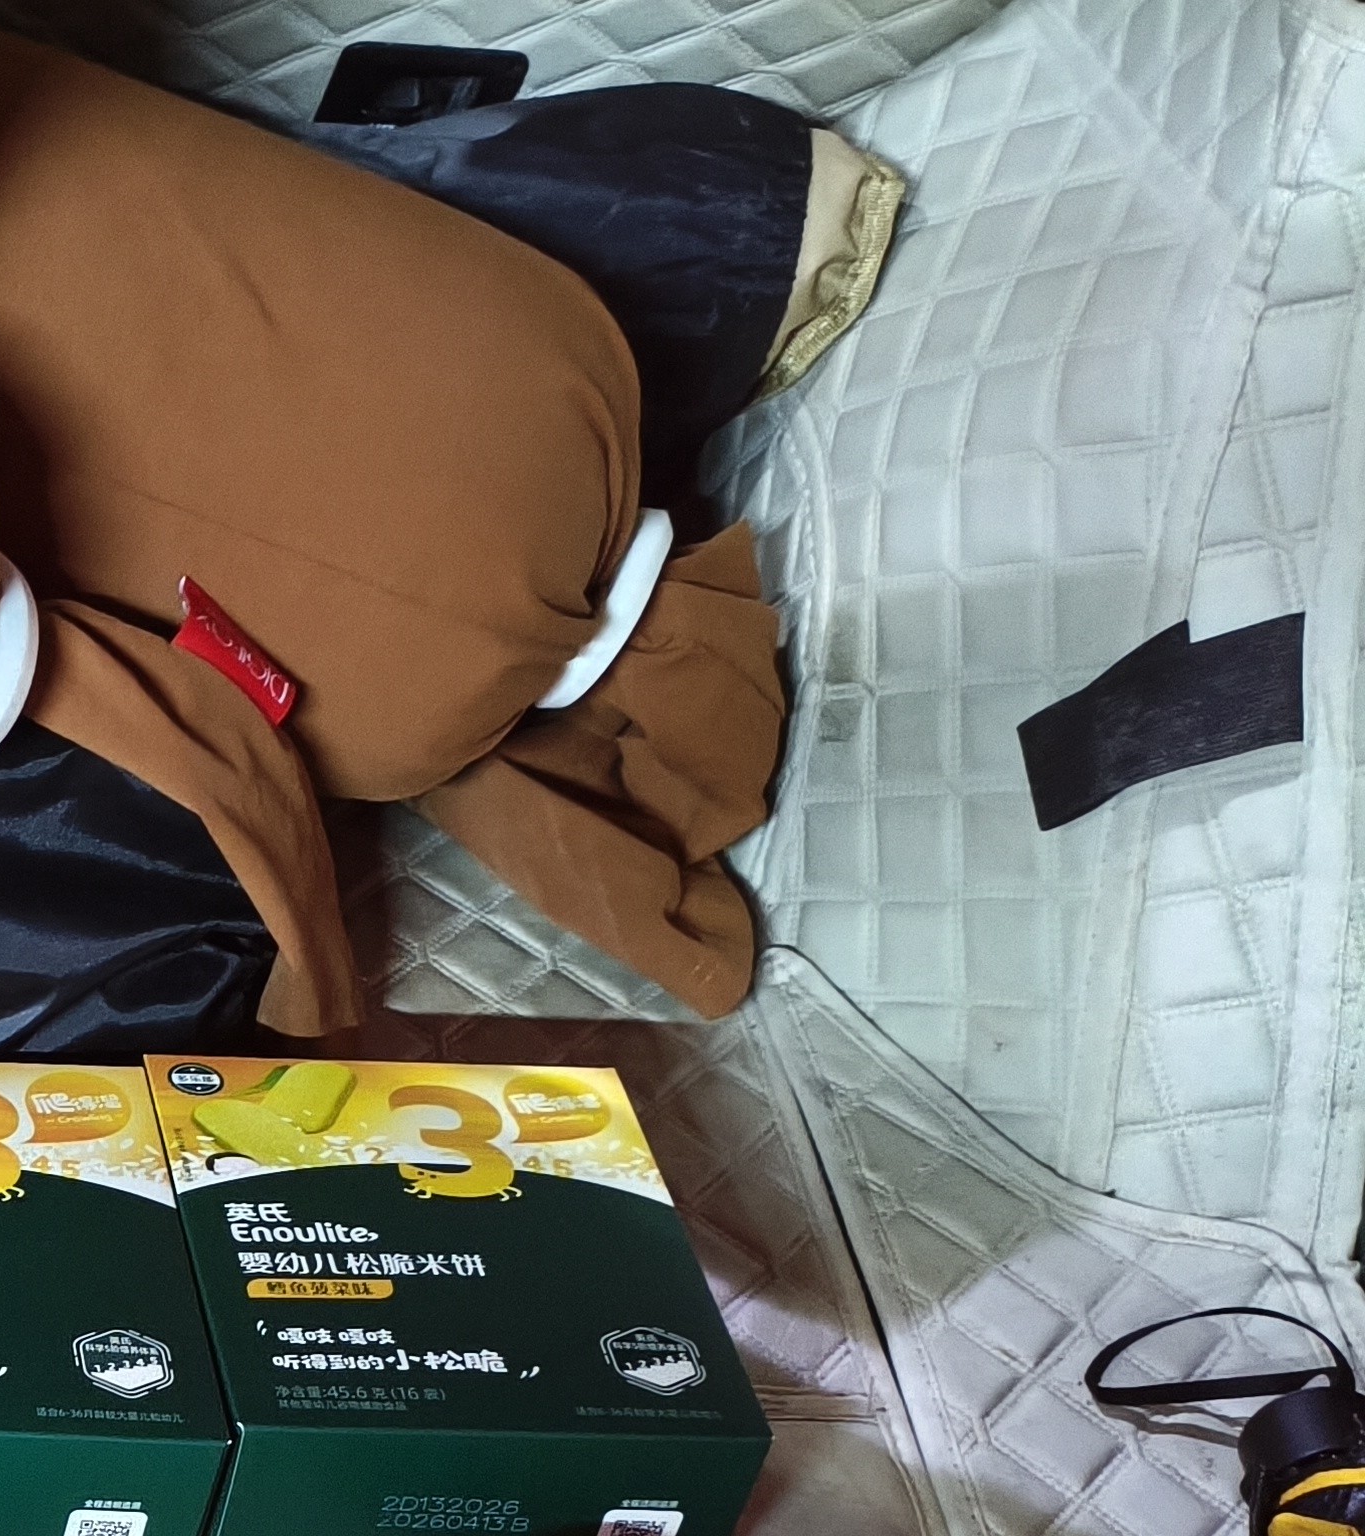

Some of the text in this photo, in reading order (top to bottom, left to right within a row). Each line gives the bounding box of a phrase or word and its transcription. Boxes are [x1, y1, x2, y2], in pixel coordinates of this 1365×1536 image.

[387, 1084, 517, 1200] 3
[224, 1202, 293, 1224] 英氏
[230, 1222, 373, 1244] Enoulite
[236, 1251, 487, 1278] 婴幼儿松脆米饼
[272, 1348, 509, 1374] 听得到的小松脆
[382, 1495, 520, 1516] 2D132026
